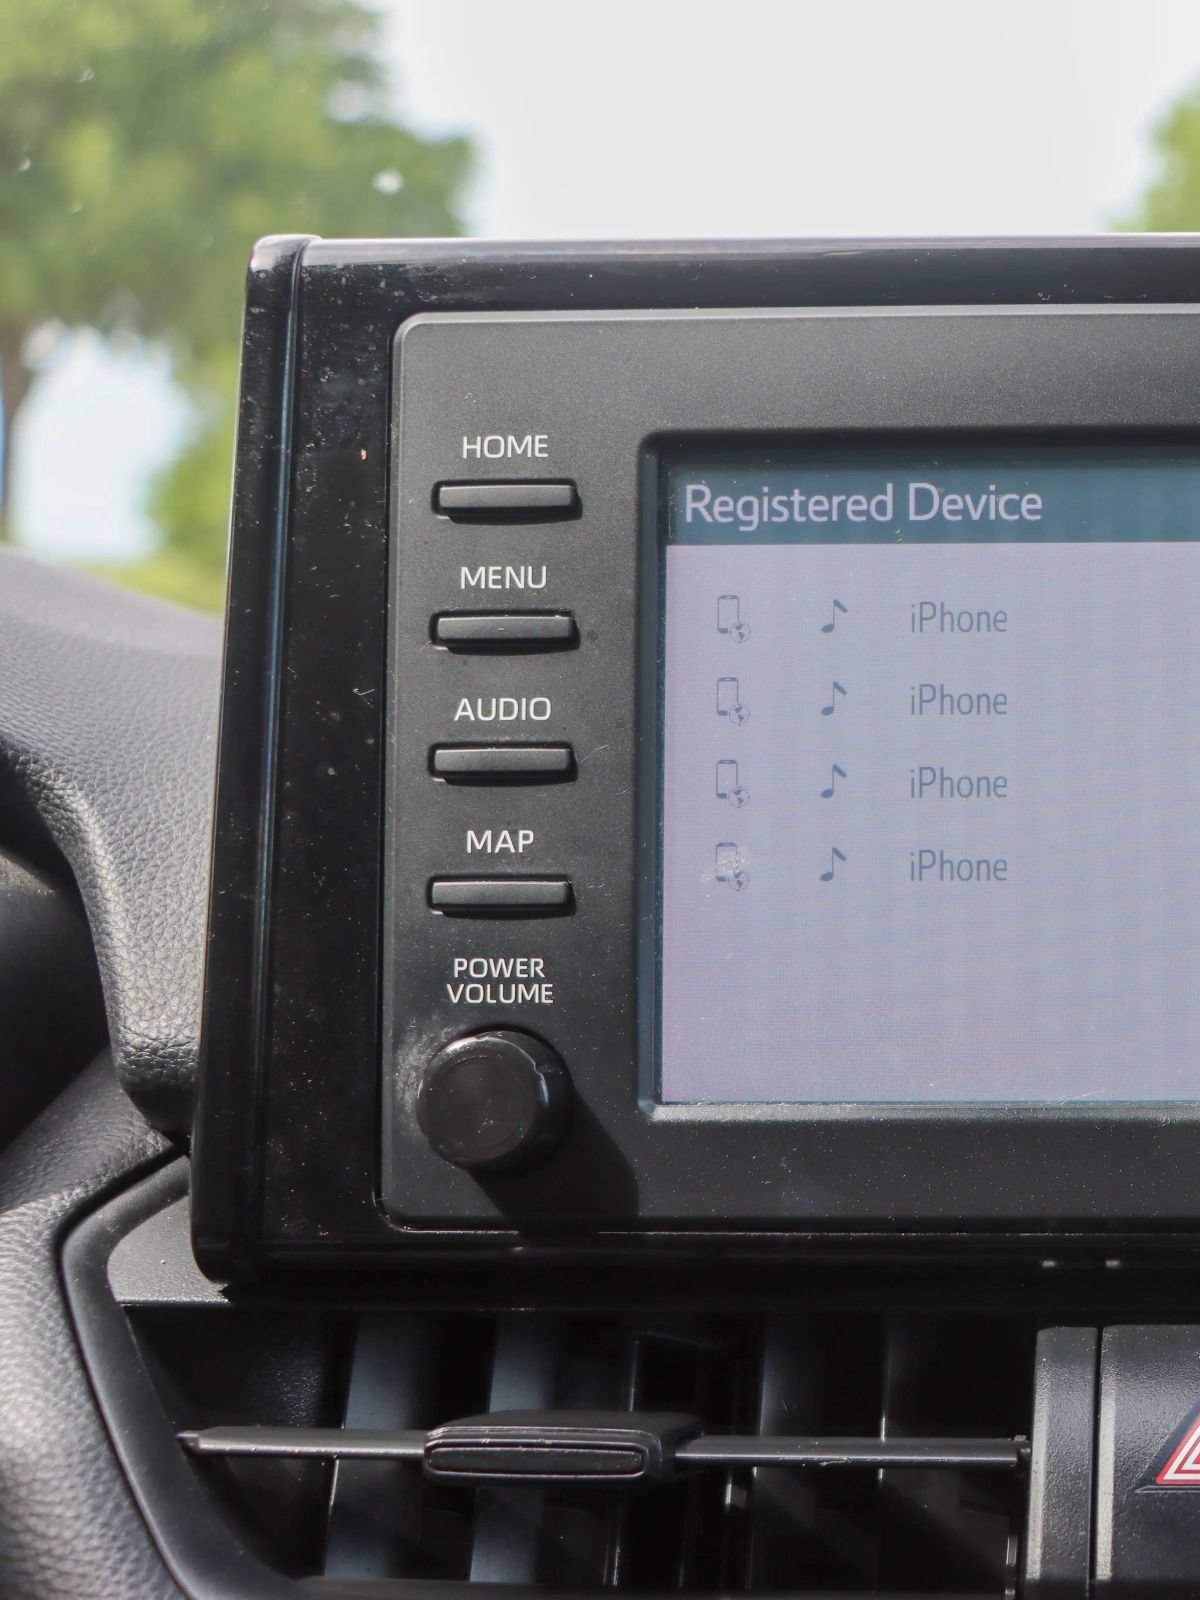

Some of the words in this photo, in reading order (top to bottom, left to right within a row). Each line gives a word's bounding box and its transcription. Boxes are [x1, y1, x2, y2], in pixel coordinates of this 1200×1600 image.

[462, 434, 550, 459] HOME
[685, 482, 894, 532] Registered
[908, 482, 1044, 522] Device
[460, 565, 547, 590] MENU
[910, 601, 1008, 633] iPhone
[453, 697, 552, 722] AUDIO
[910, 683, 1008, 716] iPhone
[910, 766, 1008, 799] iPhone
[466, 829, 535, 854] MAP
[910, 849, 1008, 882] iPhone
[453, 957, 546, 978] POWER
[446, 983, 555, 1004] VOLUME
